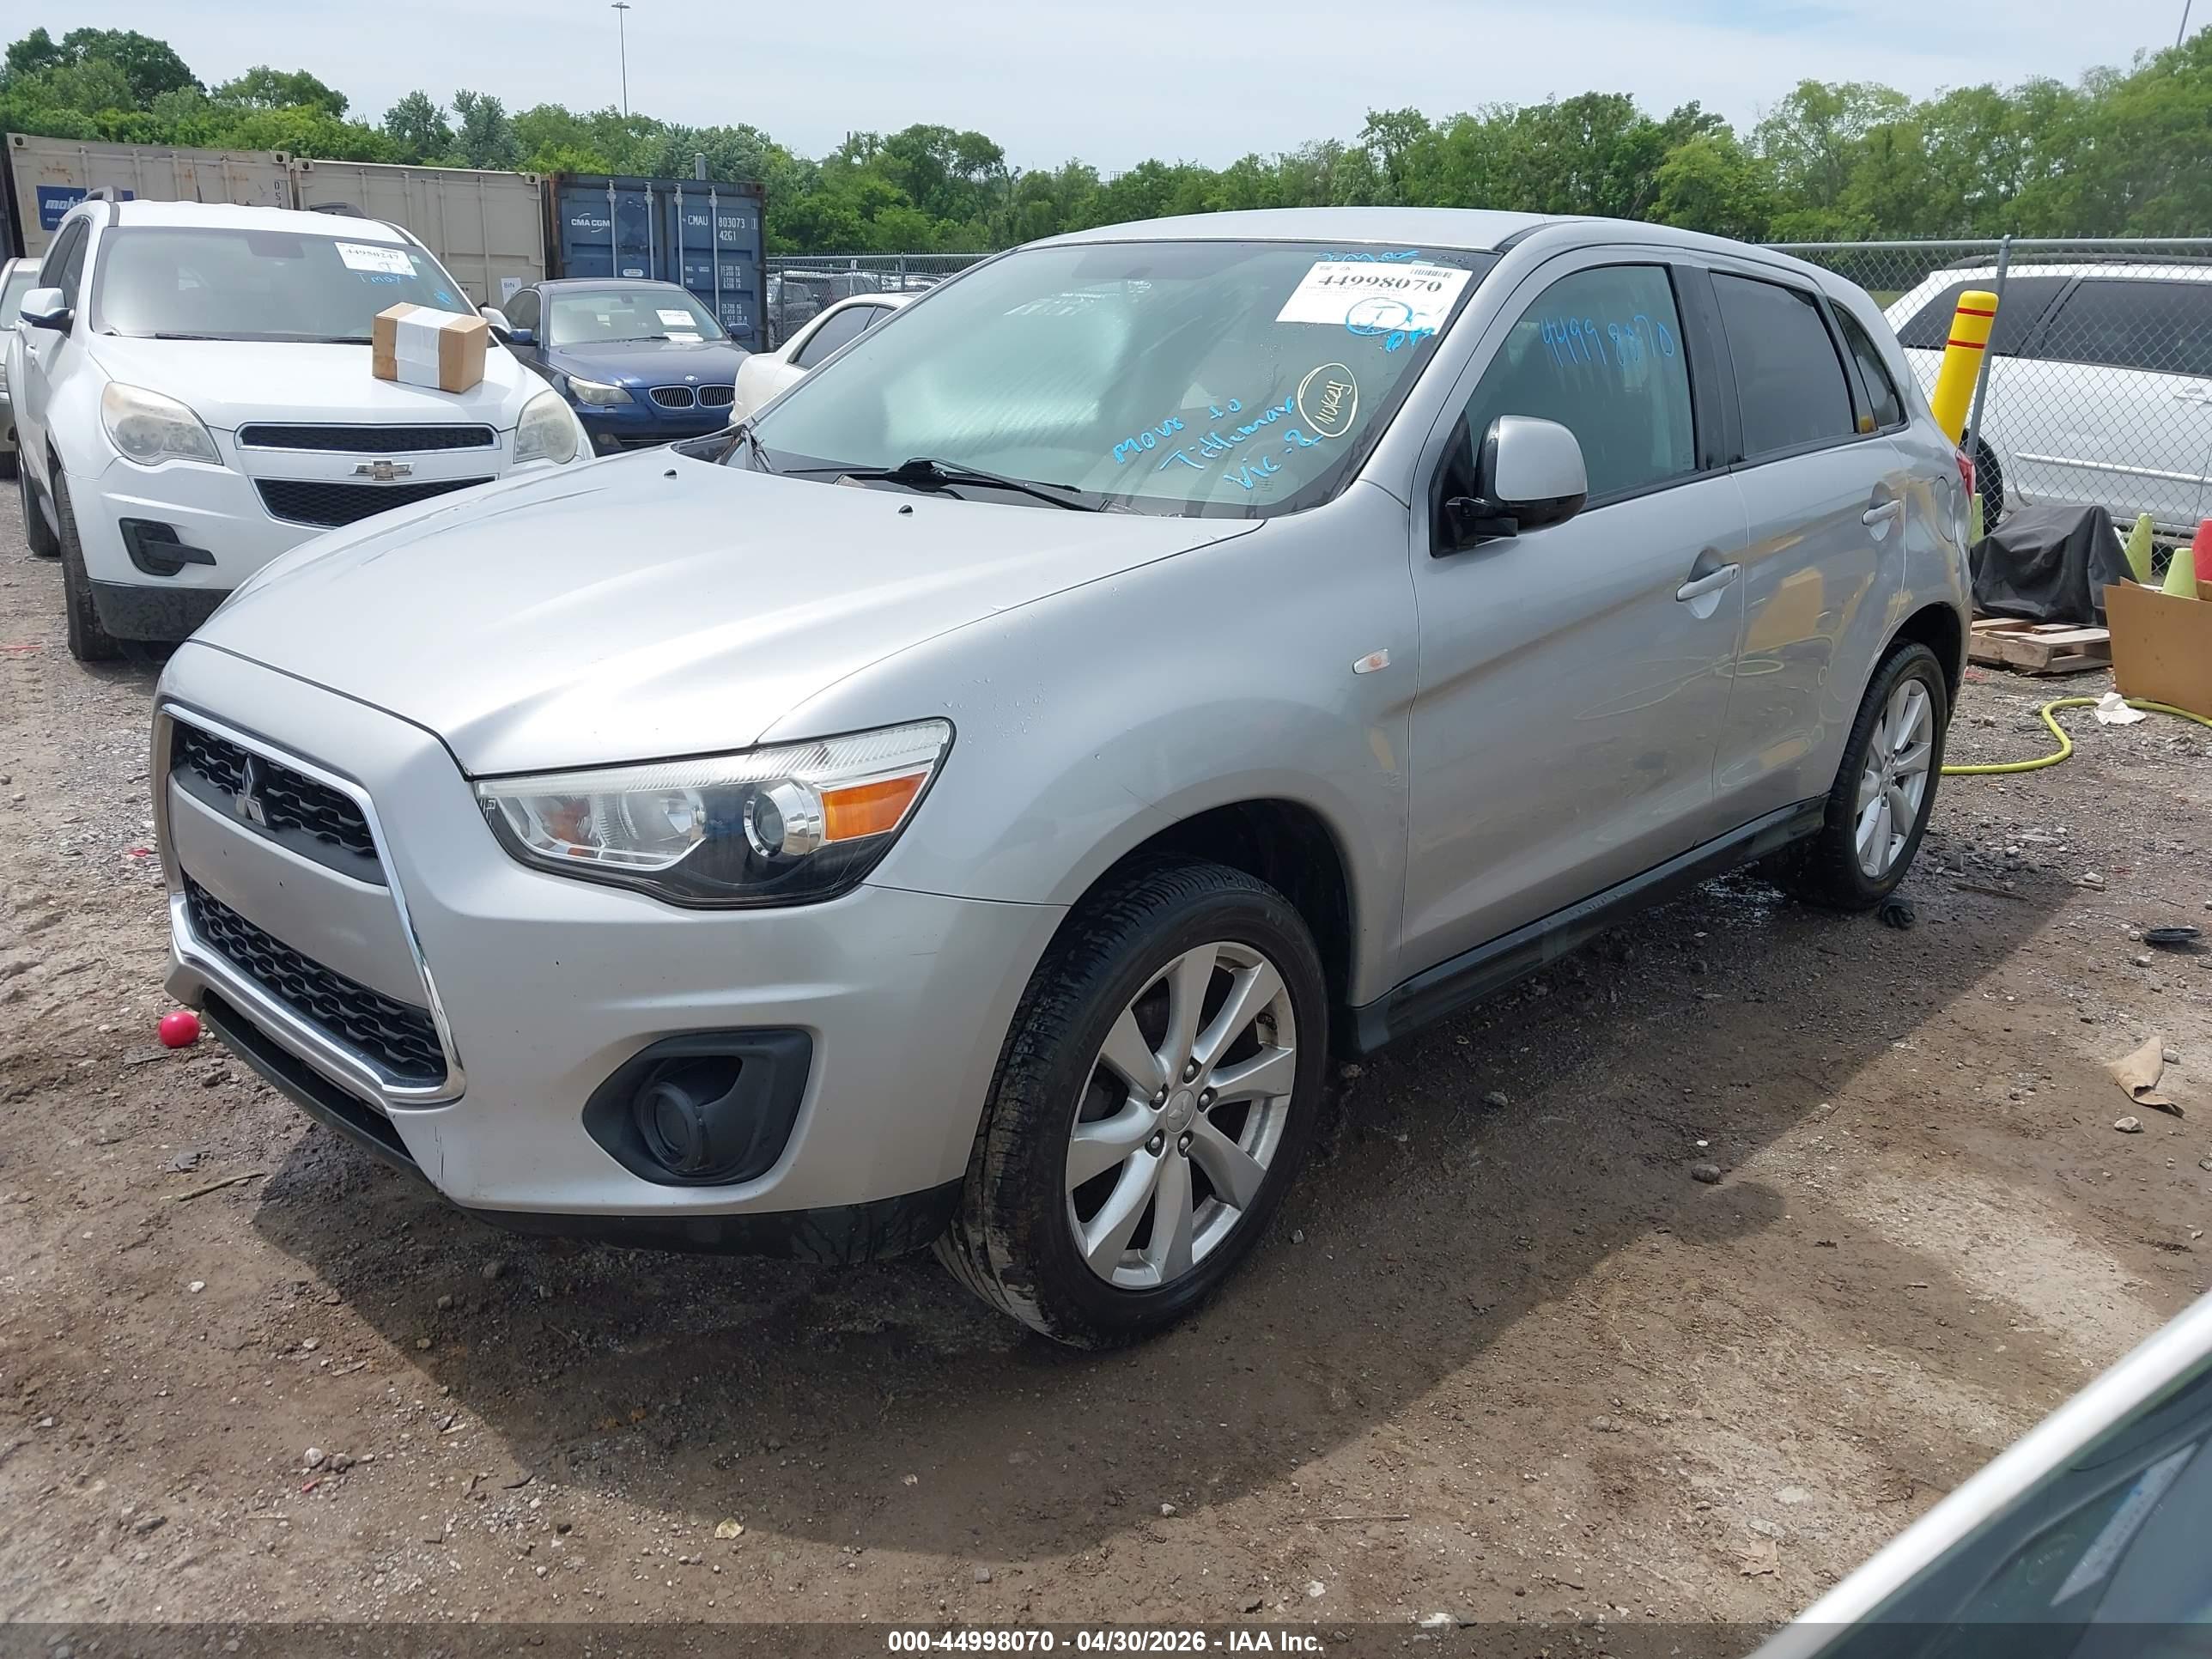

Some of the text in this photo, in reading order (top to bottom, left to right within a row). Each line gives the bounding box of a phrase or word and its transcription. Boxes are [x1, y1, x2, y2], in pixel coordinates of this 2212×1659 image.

[570, 218, 611, 228] CMA CGM
[687, 215, 708, 226] CMAU
[718, 216, 745, 228] 803073
[719, 230, 737, 241] 42G1
[1317, 274, 1443, 294] 44998070
